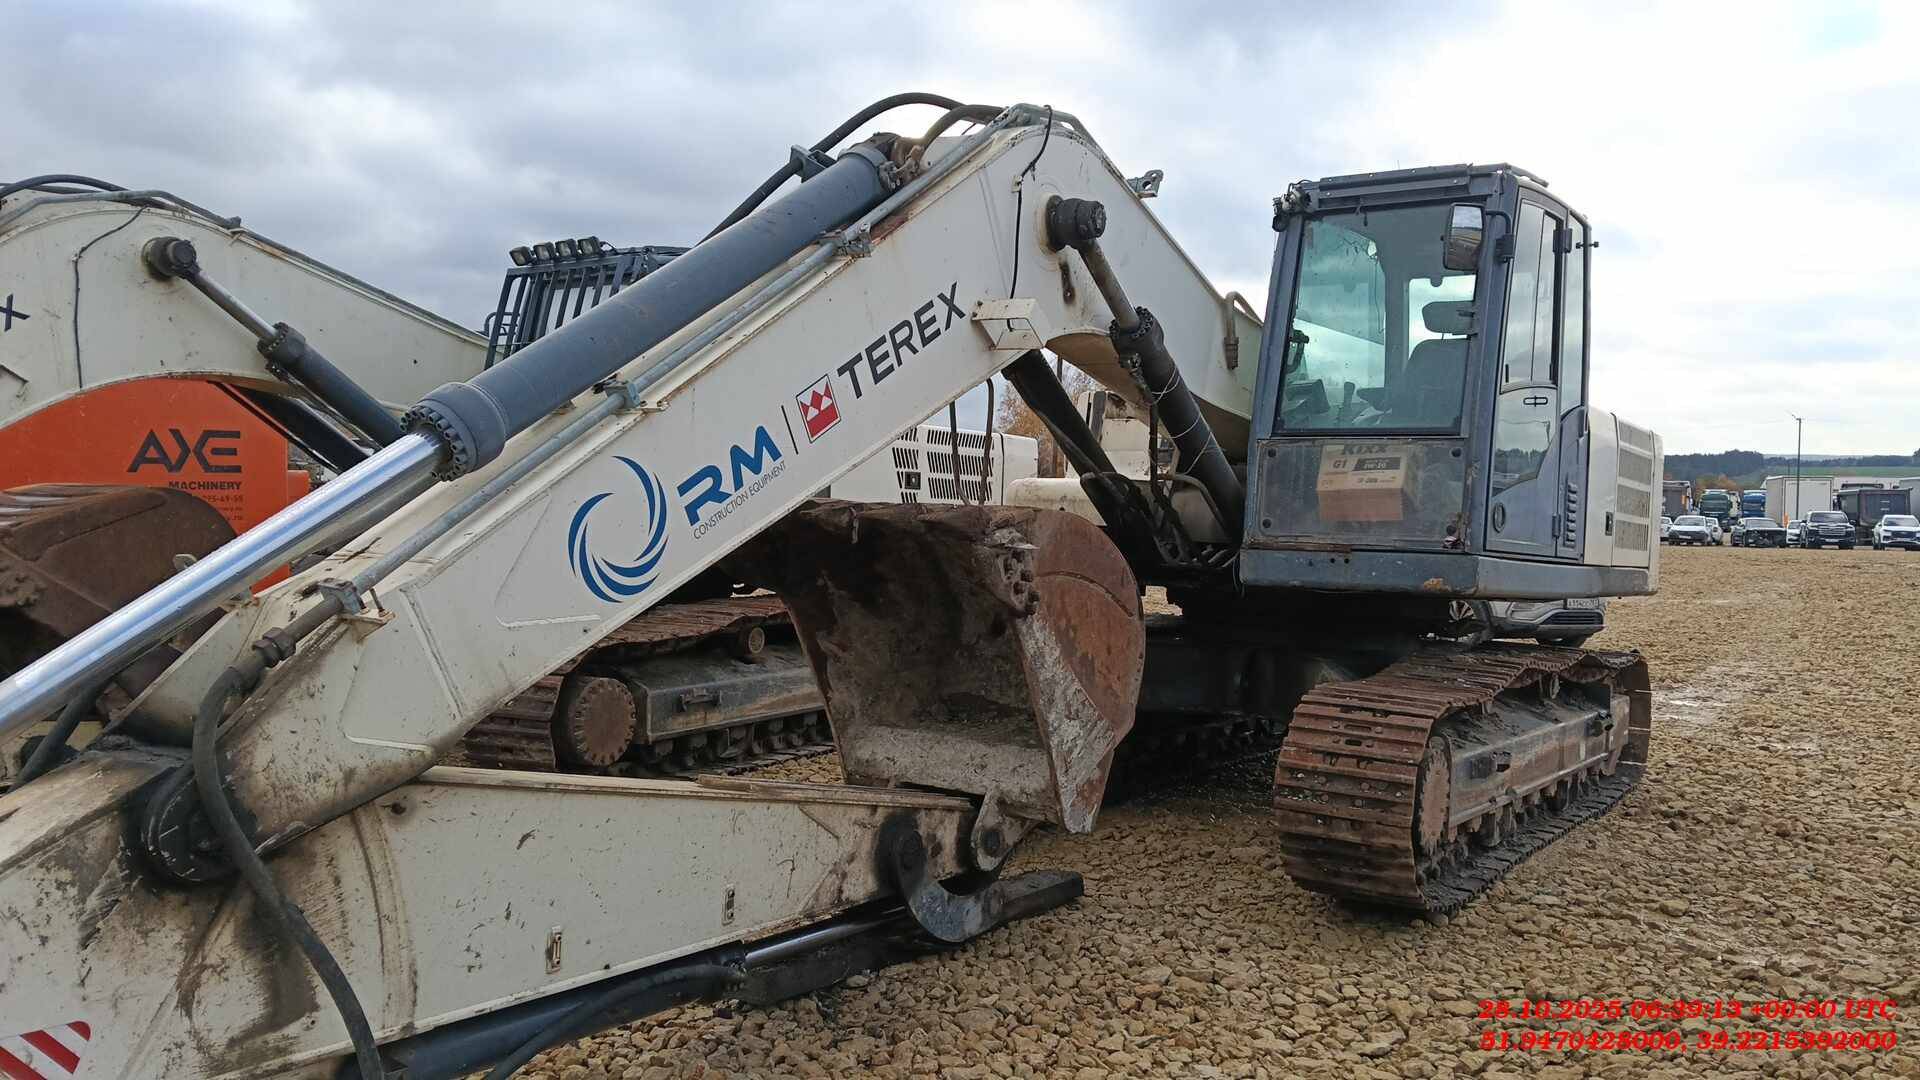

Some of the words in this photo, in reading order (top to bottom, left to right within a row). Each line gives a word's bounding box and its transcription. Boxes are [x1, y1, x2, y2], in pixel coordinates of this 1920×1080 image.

[837, 281, 966, 399] TEREX
[126, 428, 242, 473] AXE
[168, 480, 242, 490] MACHINERY
[677, 425, 782, 526] RM
[693, 491, 749, 539] CONSTRUCTION
[748, 460, 786, 496] EQUIPMENT
